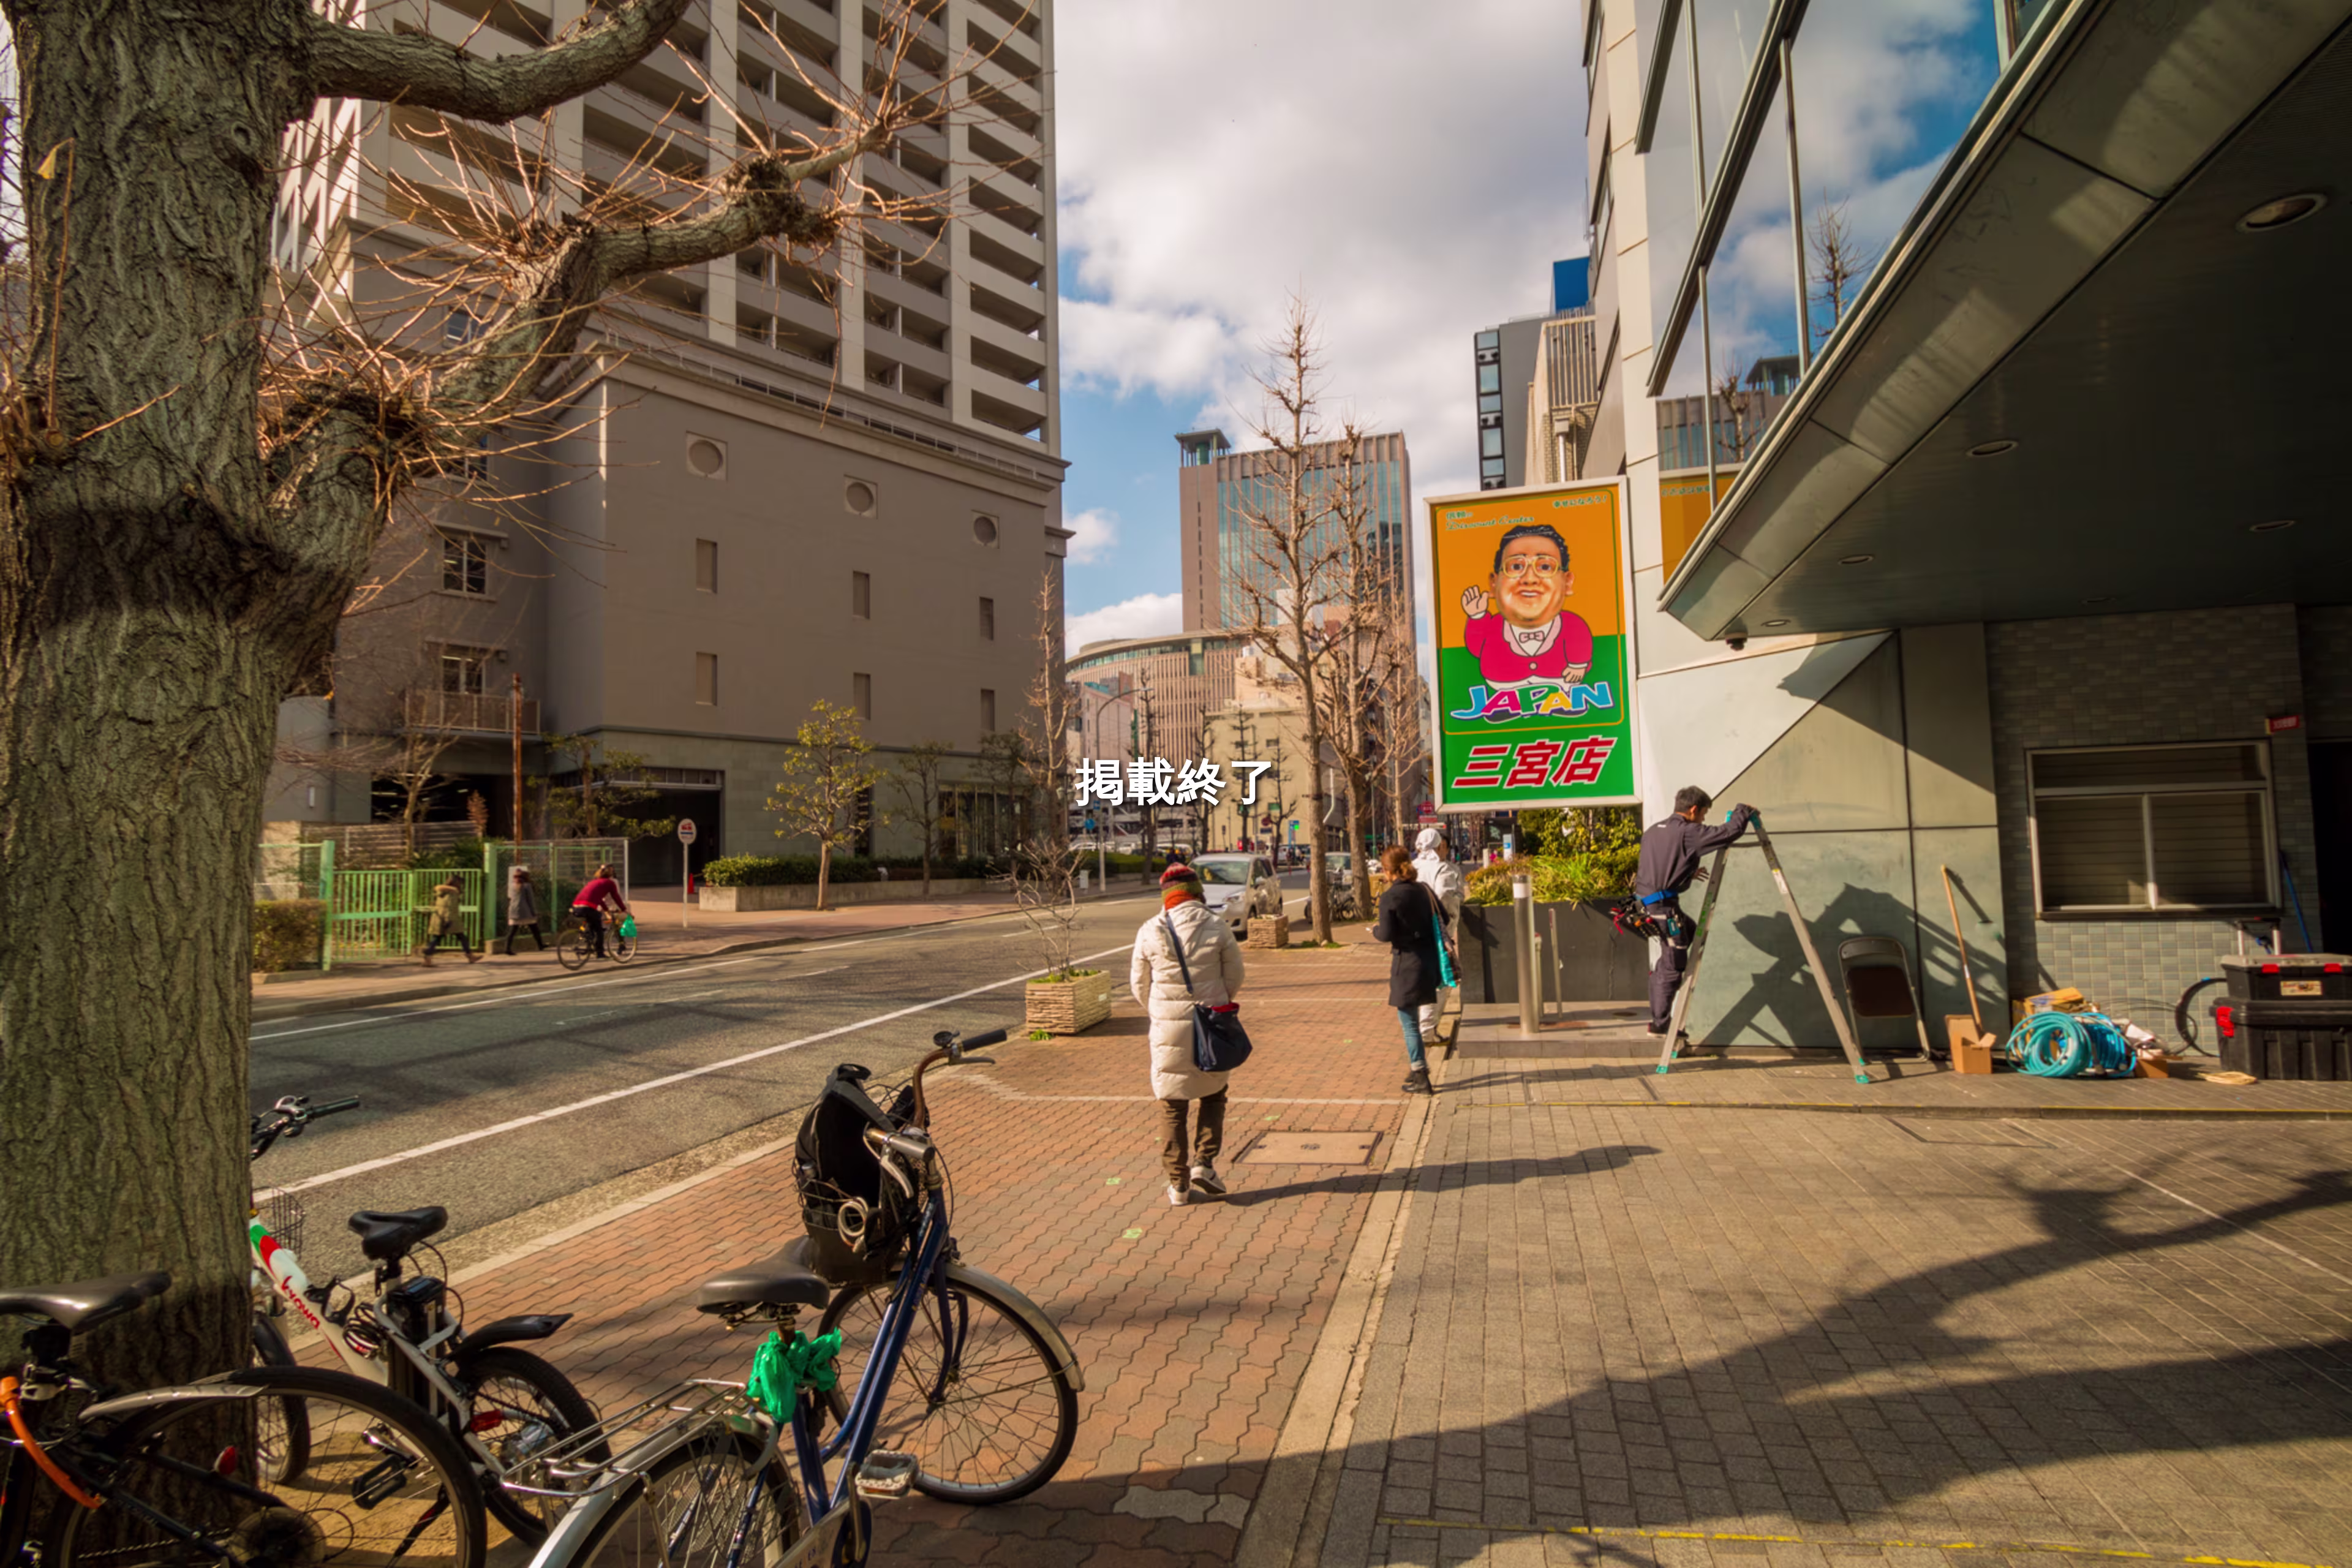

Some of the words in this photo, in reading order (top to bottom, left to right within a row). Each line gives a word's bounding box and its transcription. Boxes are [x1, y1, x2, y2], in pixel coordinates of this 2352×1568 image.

[1451, 682, 1615, 719] JAPAN
[1452, 736, 1618, 788] 三宮店
